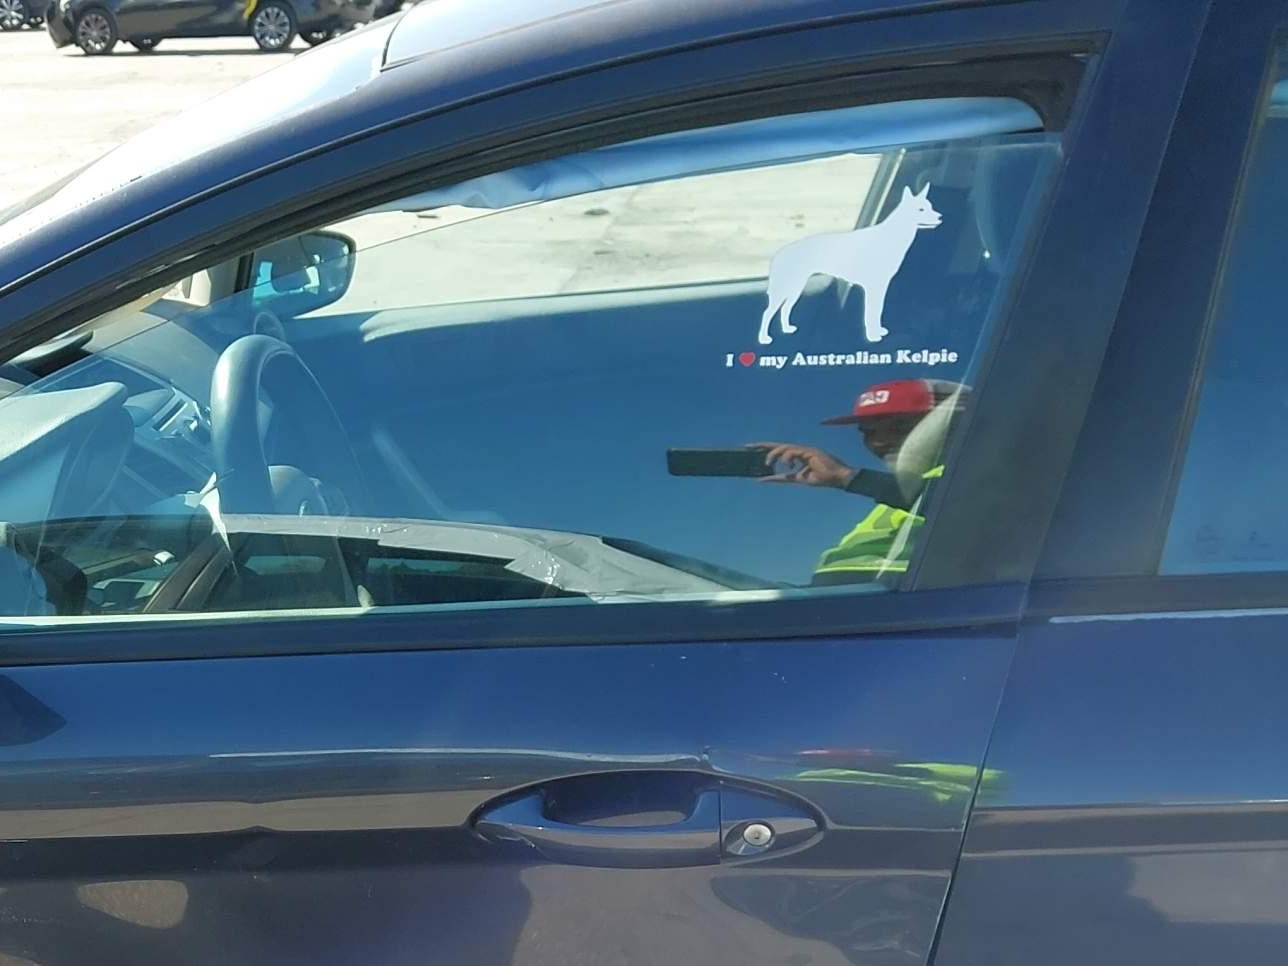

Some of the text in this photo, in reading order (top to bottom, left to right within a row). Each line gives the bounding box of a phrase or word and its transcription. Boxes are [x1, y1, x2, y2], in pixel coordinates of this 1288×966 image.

[725, 348, 959, 369] I my Australian Kelpie
